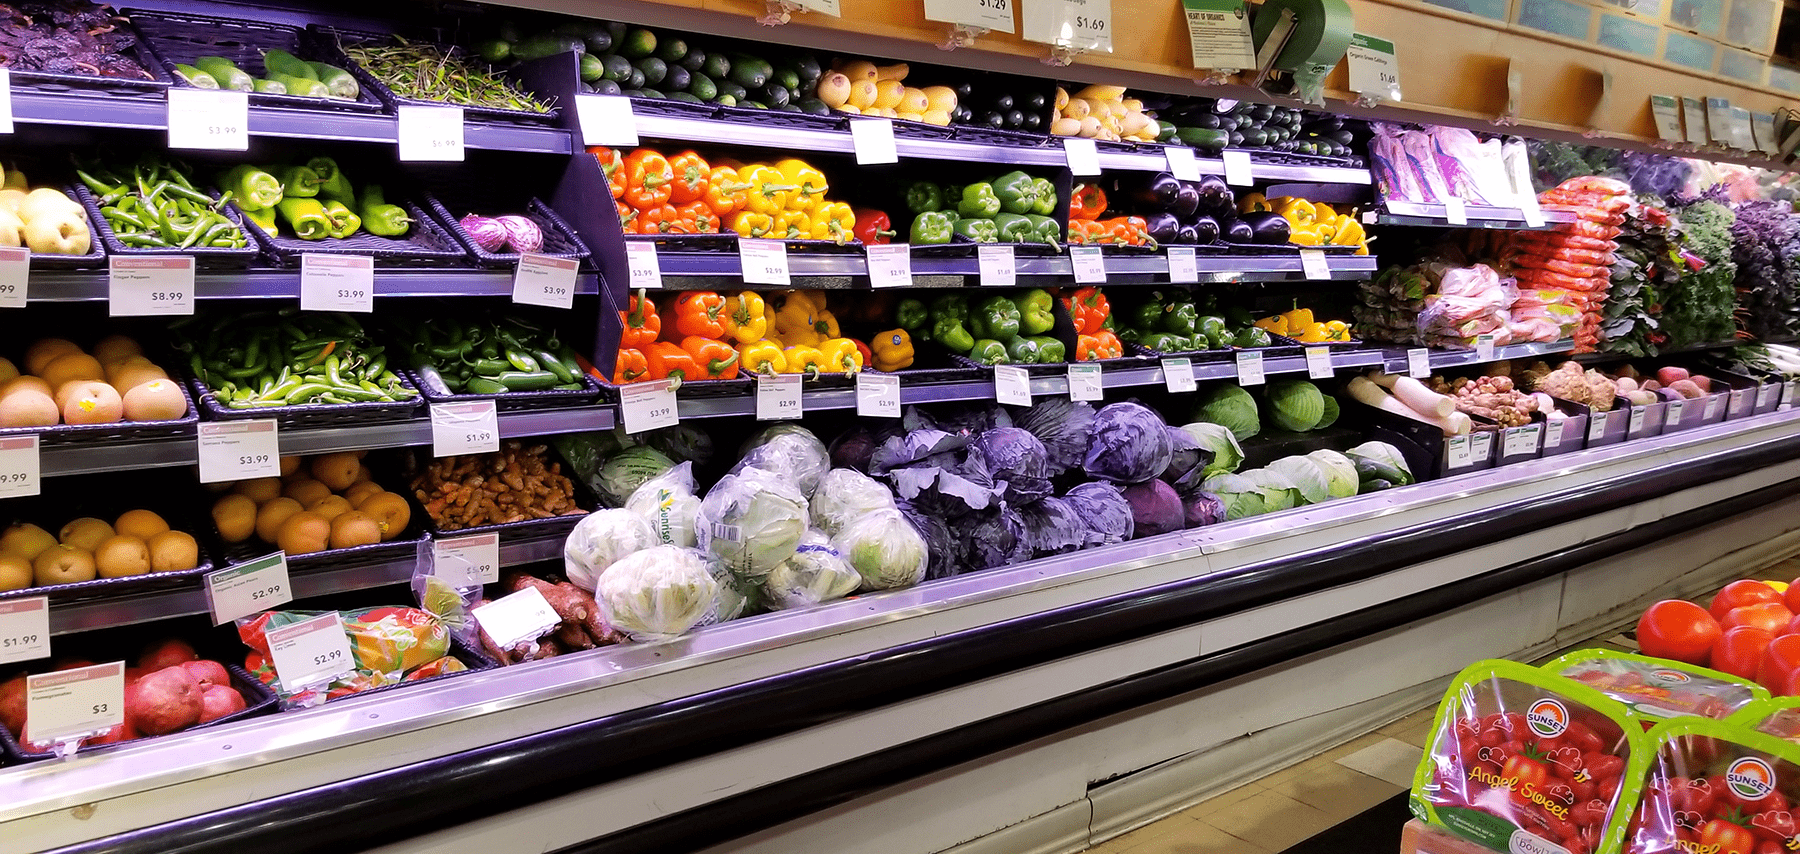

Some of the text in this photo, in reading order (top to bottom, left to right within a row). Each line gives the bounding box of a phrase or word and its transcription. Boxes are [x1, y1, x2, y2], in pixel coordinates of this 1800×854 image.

[1076, 15, 1105, 31] $1.69
[208, 126, 237, 135] $3.99
[115, 259, 163, 268] Conventional
[632, 269, 653, 277] $3.99
[337, 289, 365, 298] $3.99
[543, 285, 566, 295] $3.99
[151, 292, 183, 301] $8.99
[650, 407, 670, 418] $3.99
[466, 432, 491, 442] $1.99
[239, 454, 269, 465] $3.99
[214, 570, 241, 581] Organic
[252, 584, 281, 600] $2.99
[3, 634, 38, 648] $1.99
[314, 649, 342, 665] $2.99
[34, 670, 89, 687] Conventional
[92, 703, 108, 715] $3
[1527, 713, 1566, 732] SUNSET
[1727, 773, 1772, 794] SUNSET
[1467, 765, 1520, 792] Angel
[1520, 782, 1570, 822] Sweet
